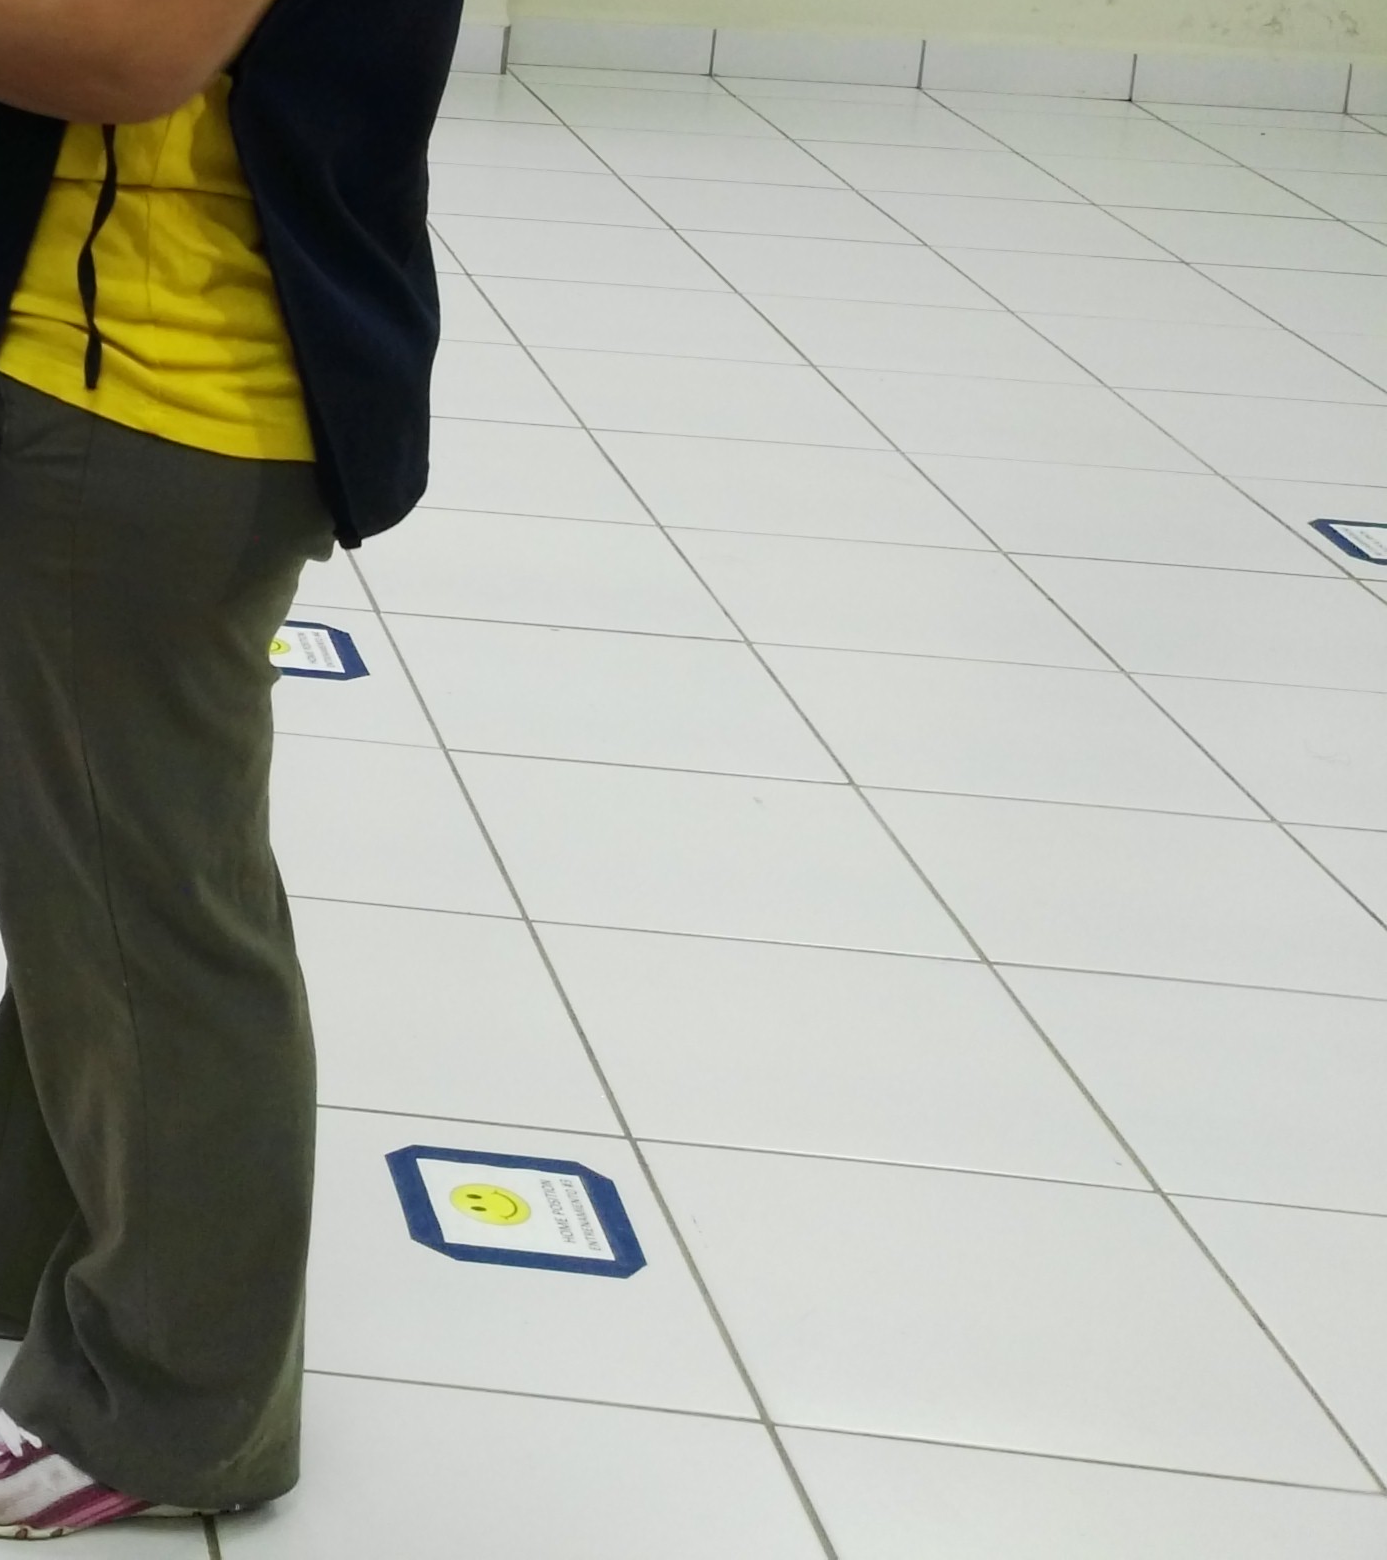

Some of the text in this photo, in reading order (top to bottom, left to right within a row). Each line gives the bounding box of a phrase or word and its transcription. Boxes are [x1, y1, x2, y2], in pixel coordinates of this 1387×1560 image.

[540, 1178, 576, 1243] HOME POSITION
[564, 1187, 602, 1251] ENTRENAMIENTO
